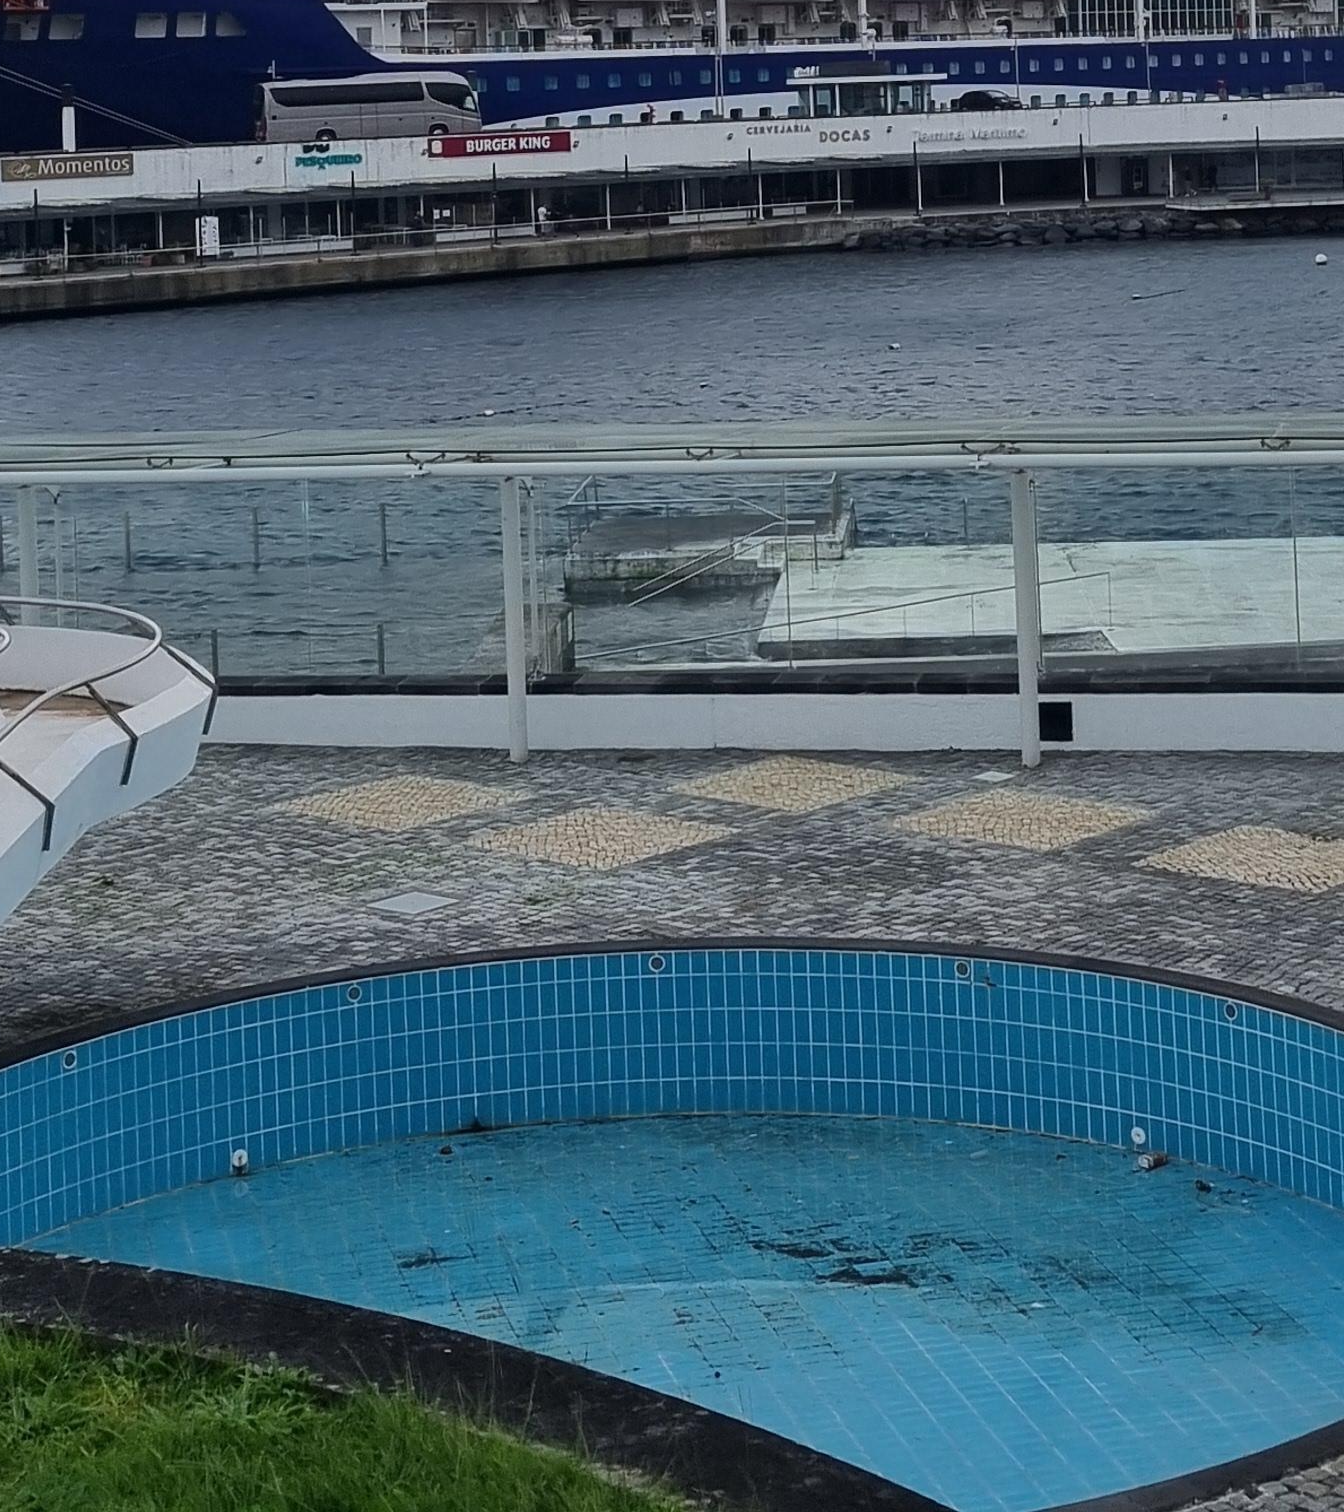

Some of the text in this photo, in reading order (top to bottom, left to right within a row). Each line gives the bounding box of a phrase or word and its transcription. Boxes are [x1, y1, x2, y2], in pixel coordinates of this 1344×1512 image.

[746, 124, 871, 143] CERVEJARIA DOCAS
[466, 136, 551, 152] BURGER KING
[37, 157, 130, 175] Momentos
